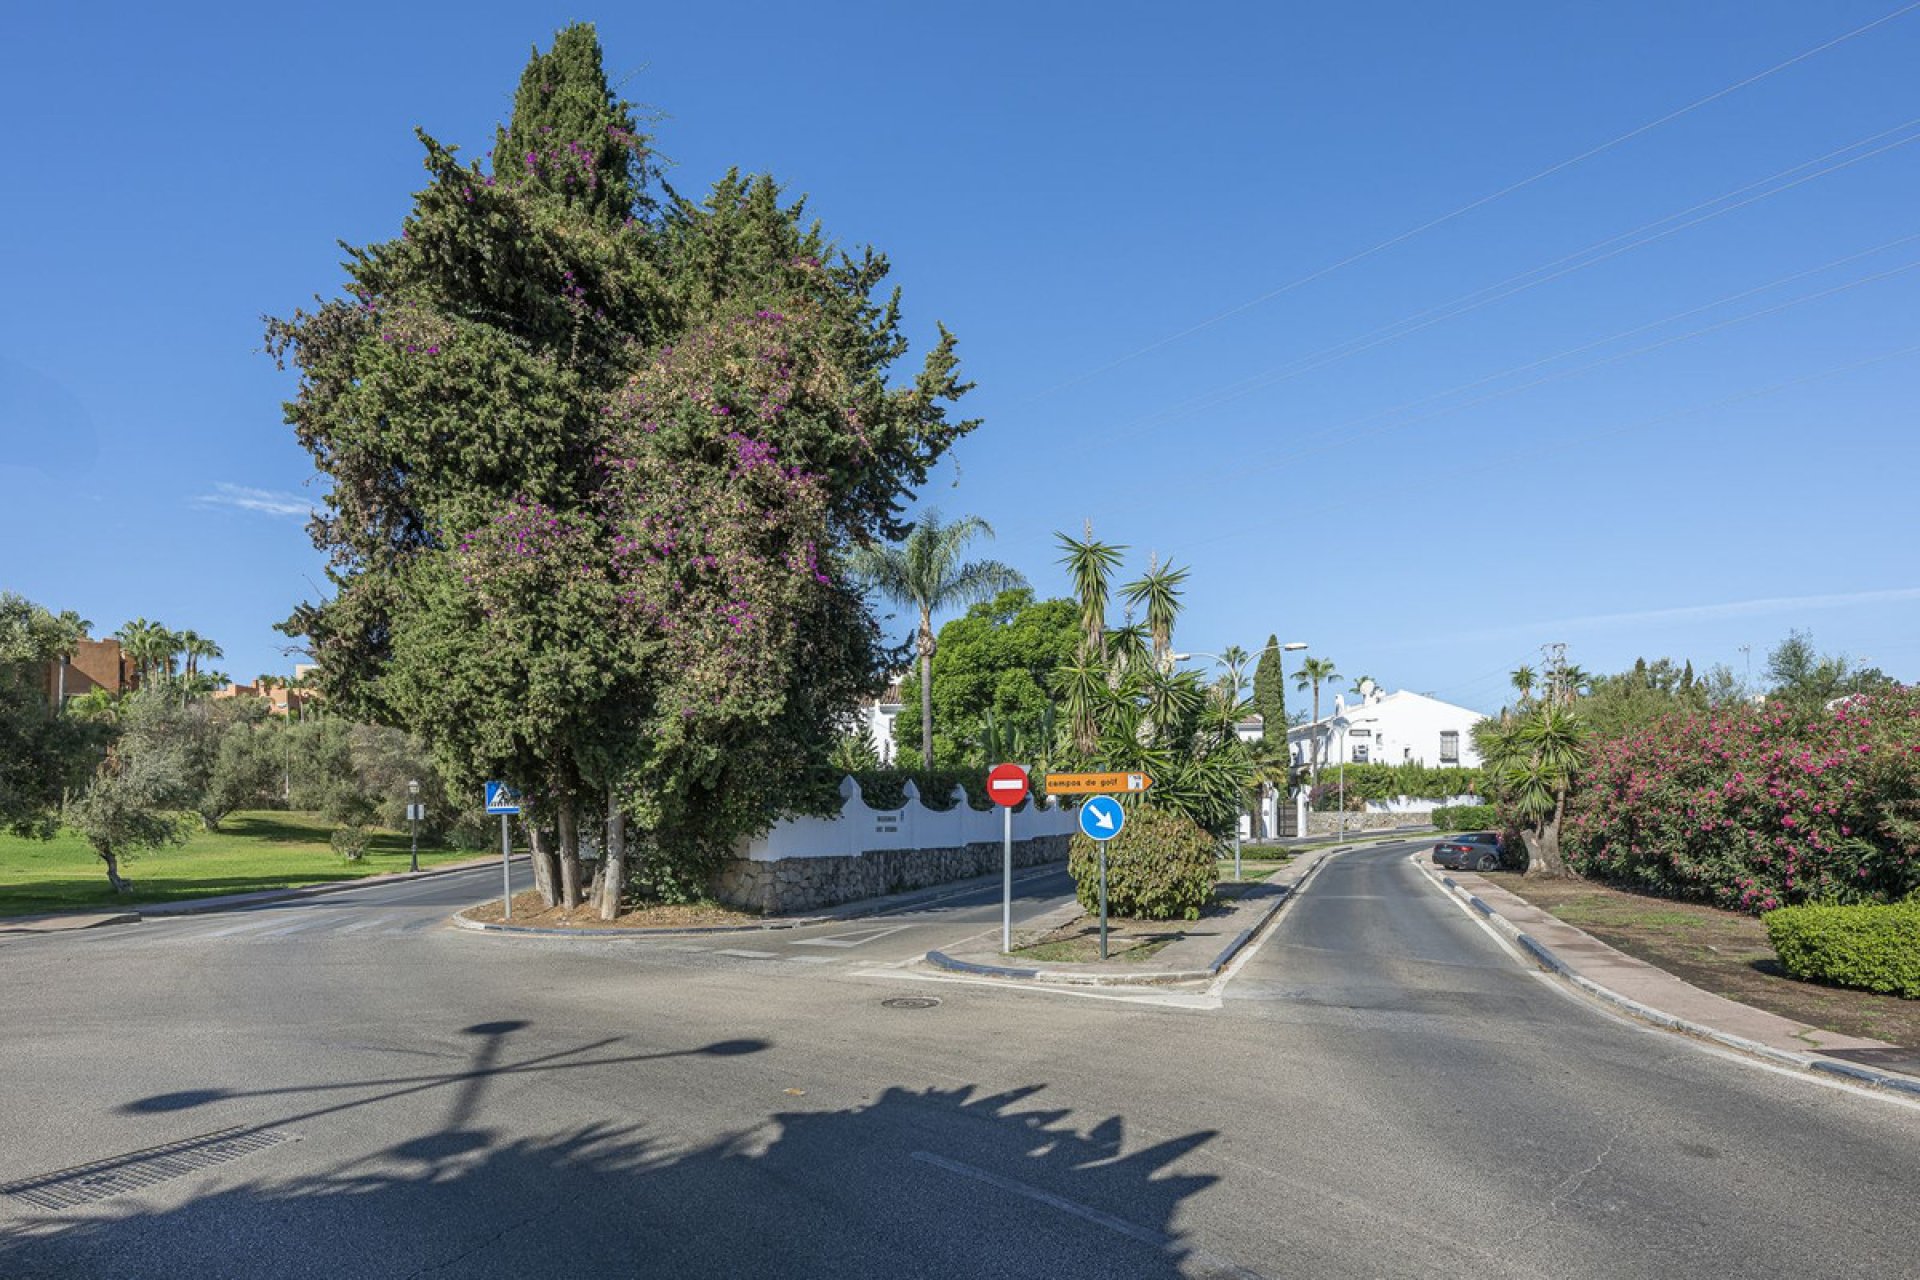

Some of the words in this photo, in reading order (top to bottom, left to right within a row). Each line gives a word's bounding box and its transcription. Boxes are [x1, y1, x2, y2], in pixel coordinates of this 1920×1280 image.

[1048, 780, 1081, 788] campos
[1085, 778, 1097, 786] de
[1100, 778, 1118, 788] golf
